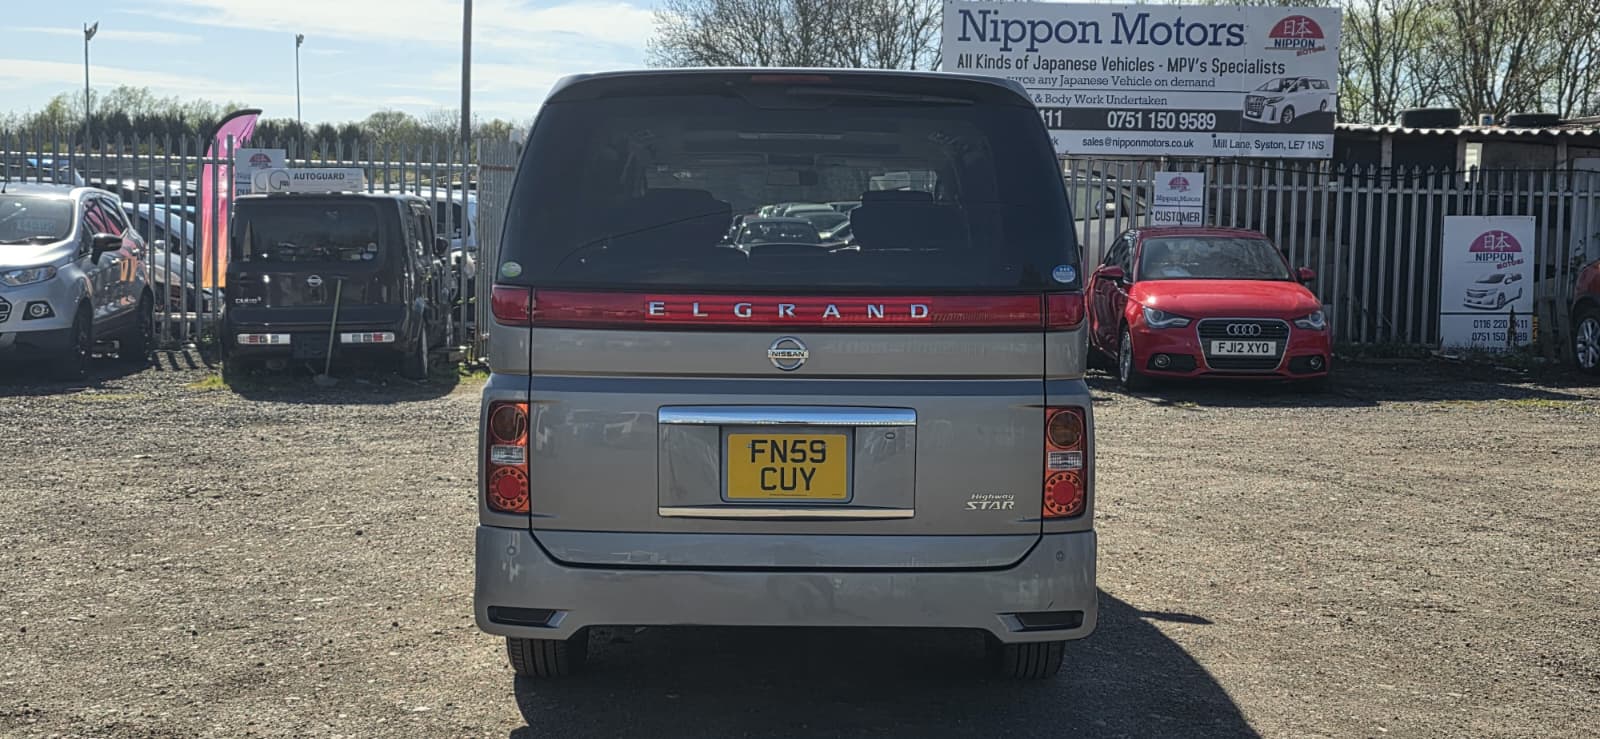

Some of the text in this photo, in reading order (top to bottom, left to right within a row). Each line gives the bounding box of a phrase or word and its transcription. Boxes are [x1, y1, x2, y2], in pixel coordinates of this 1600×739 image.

[957, 9, 1245, 52] Nippon Motors
[1283, 17, 1313, 38] 日本
[1274, 38, 1316, 48] NIPPON
[957, 53, 973, 69] All
[975, 54, 1012, 70] Kinds
[1015, 55, 1030, 70] of
[1033, 56, 1097, 74] Japanese
[1101, 56, 1155, 72] Vehicles
[1167, 57, 1208, 73] MPV's
[1211, 57, 1286, 76] Specialists
[1038, 76, 1058, 87] any
[1060, 75, 1109, 87] Japanese
[1111, 75, 1152, 87] Vehicle
[1154, 79, 1168, 87] on
[1170, 77, 1216, 88] demand
[1034, 94, 1168, 105] & Body Work Undertaken
[1107, 110, 1142, 128] 0751
[1148, 111, 1176, 129] 150
[1179, 112, 1217, 130] 9589
[1082, 136, 1195, 149] sales@nipponmotors.co.uk
[1212, 139, 1325, 151] Mill Lane, Syston, LE7 1NS
[294, 172, 345, 181] AUTOGUARD
[1155, 210, 1200, 223] CUSTOMER
[1483, 231, 1511, 251] 日本
[1475, 253, 1515, 262] NIPPON
[649, 301, 929, 319] ELGRAND
[1473, 319, 1491, 329] 0116
[1493, 319, 1508, 329] 220
[1471, 331, 1490, 342] 0751
[1492, 331, 1506, 342] 150
[1218, 342, 1269, 353] FJ12 XYO
[750, 439, 827, 463] FN59
[760, 466, 817, 491] CUY
[971, 493, 1015, 501] Highway
[964, 501, 1015, 510] STAR
